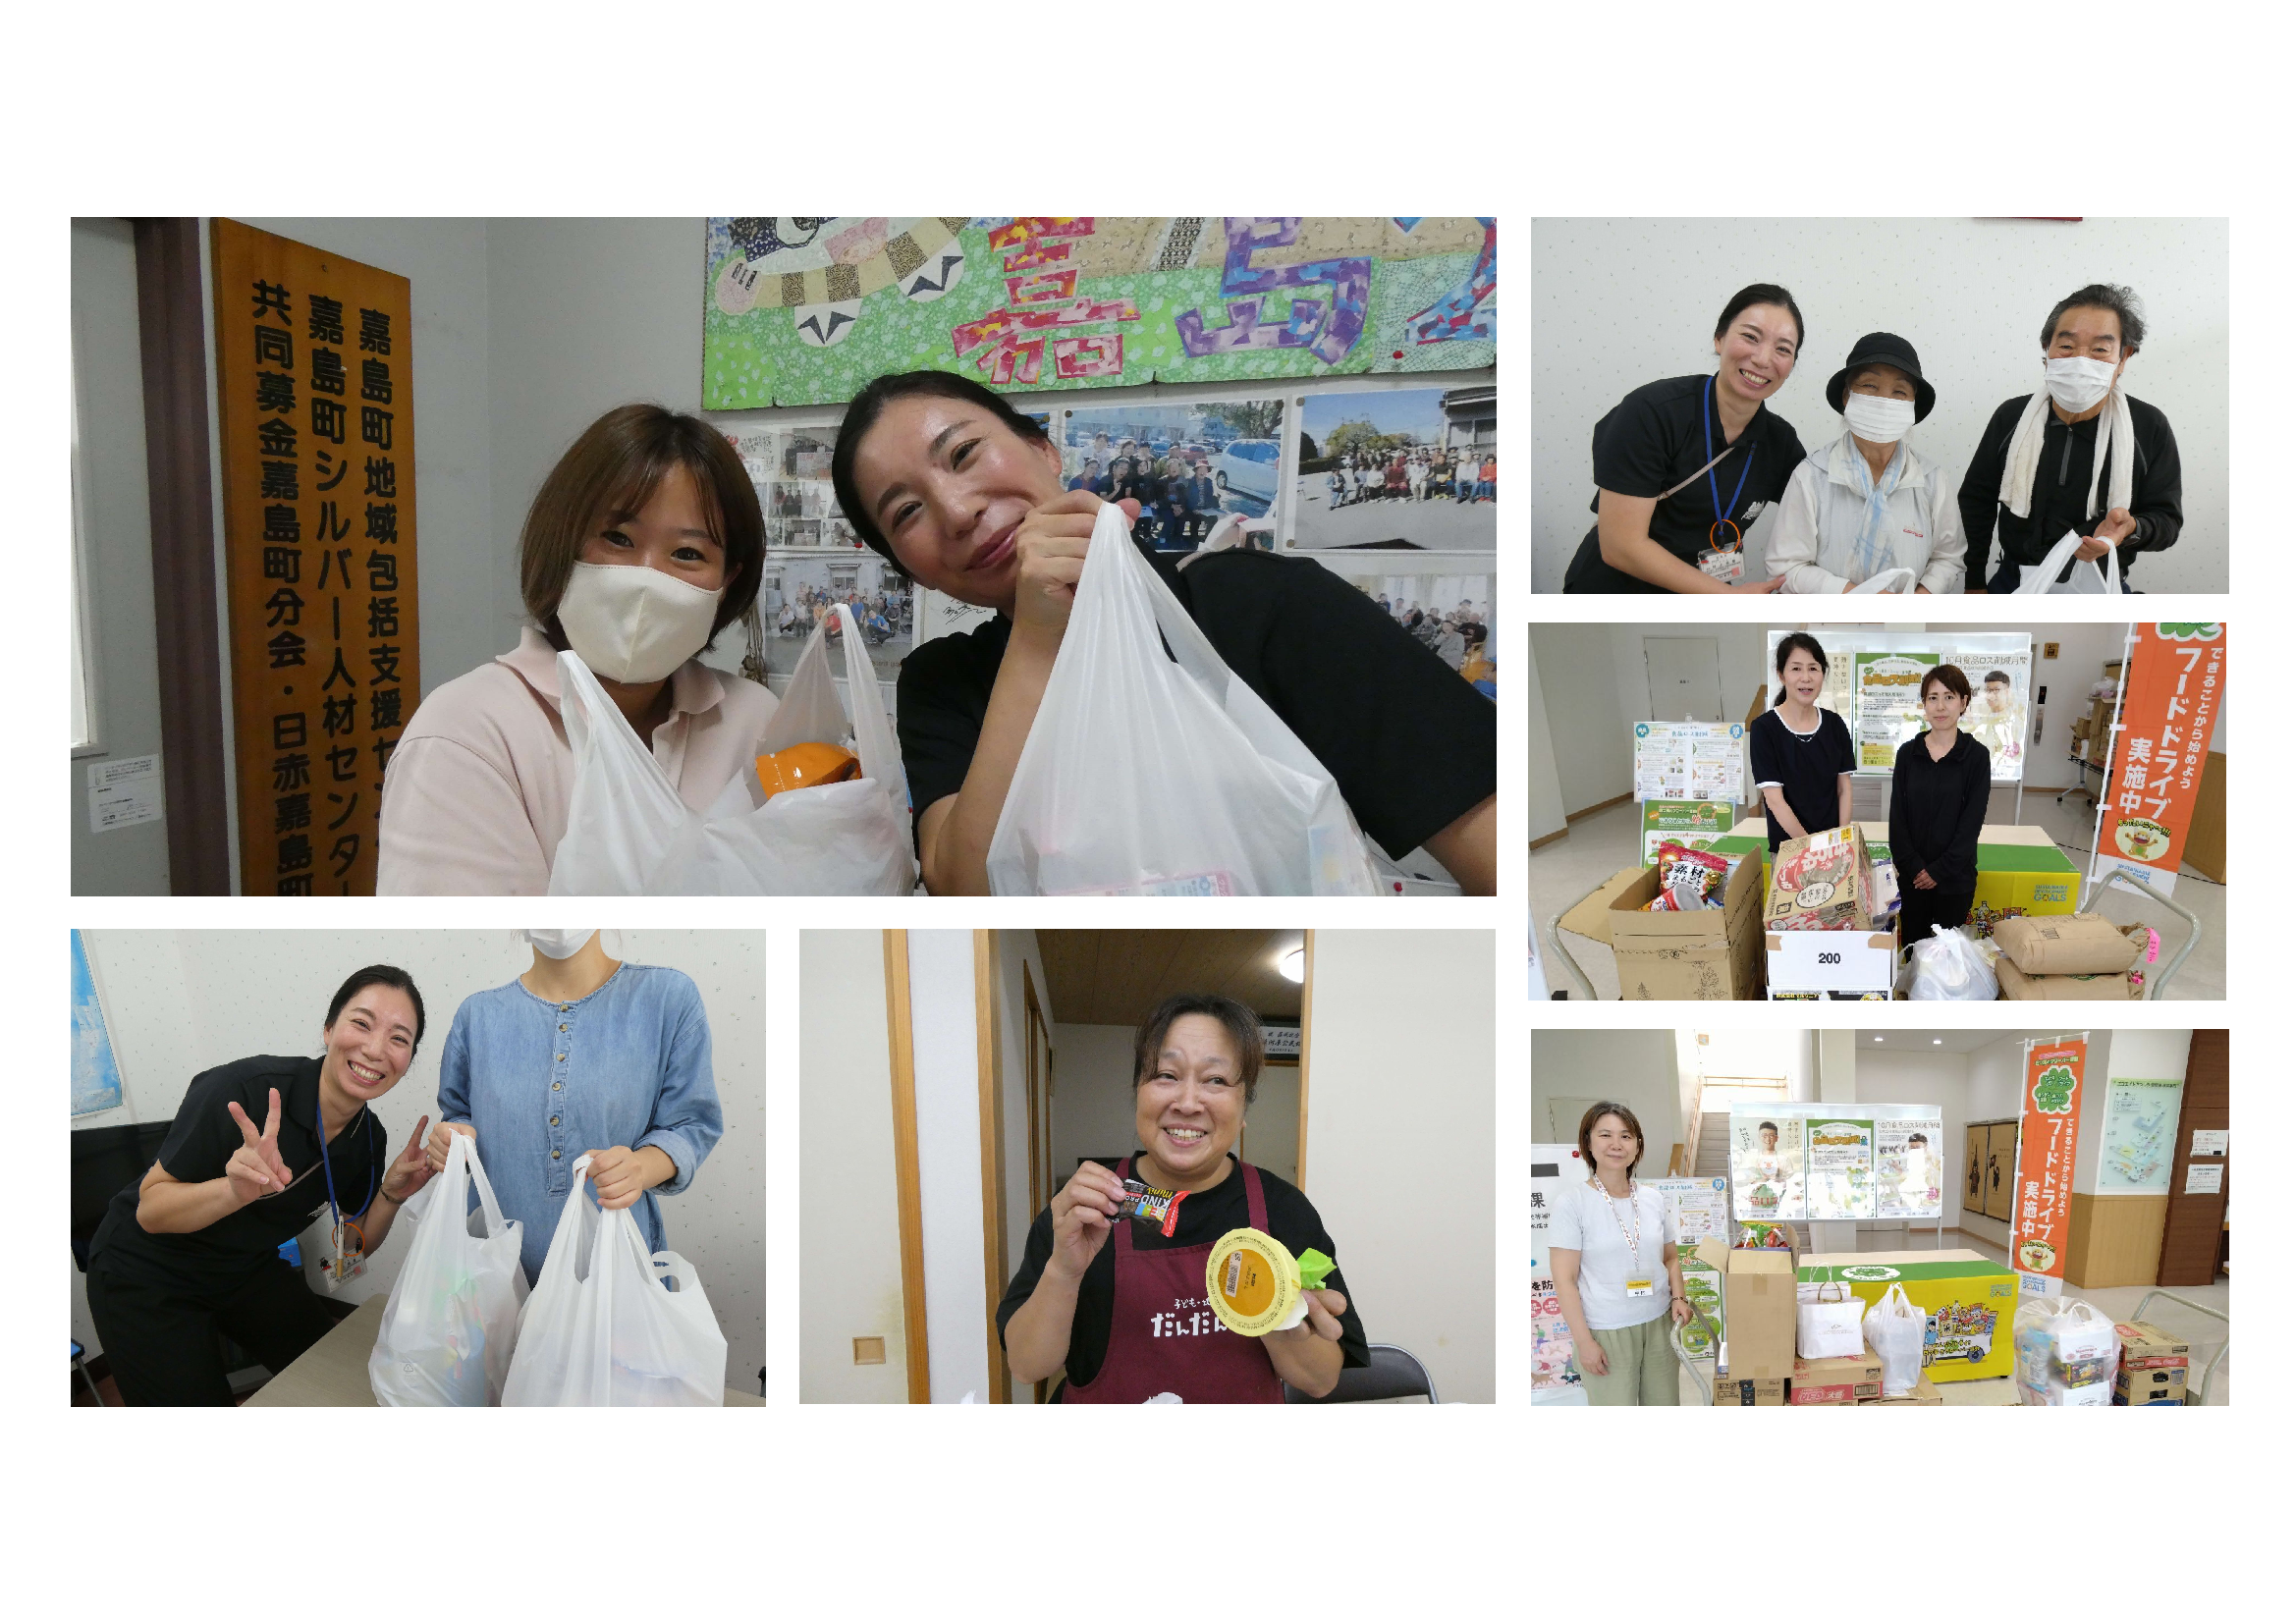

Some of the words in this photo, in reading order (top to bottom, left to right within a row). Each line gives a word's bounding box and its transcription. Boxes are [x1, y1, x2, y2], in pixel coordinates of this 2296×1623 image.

[952, 217, 1496, 384] 嘉島
[359, 307, 402, 846] 嘉島町地域包括支援セ
[2145, 648, 2202, 820] フードドライブ
[2179, 647, 2223, 789] できることから始めよう
[2118, 736, 2153, 815] 実施中
[1819, 952, 1841, 964] 200
[1140, 1194, 1172, 1209] KIND
[2021, 1180, 2040, 1238] 実施中
[2037, 1118, 2062, 1240] フードドライブ
[2057, 1118, 2075, 1217] できることから始めよう
[1150, 1312, 1228, 1337] だんだん
